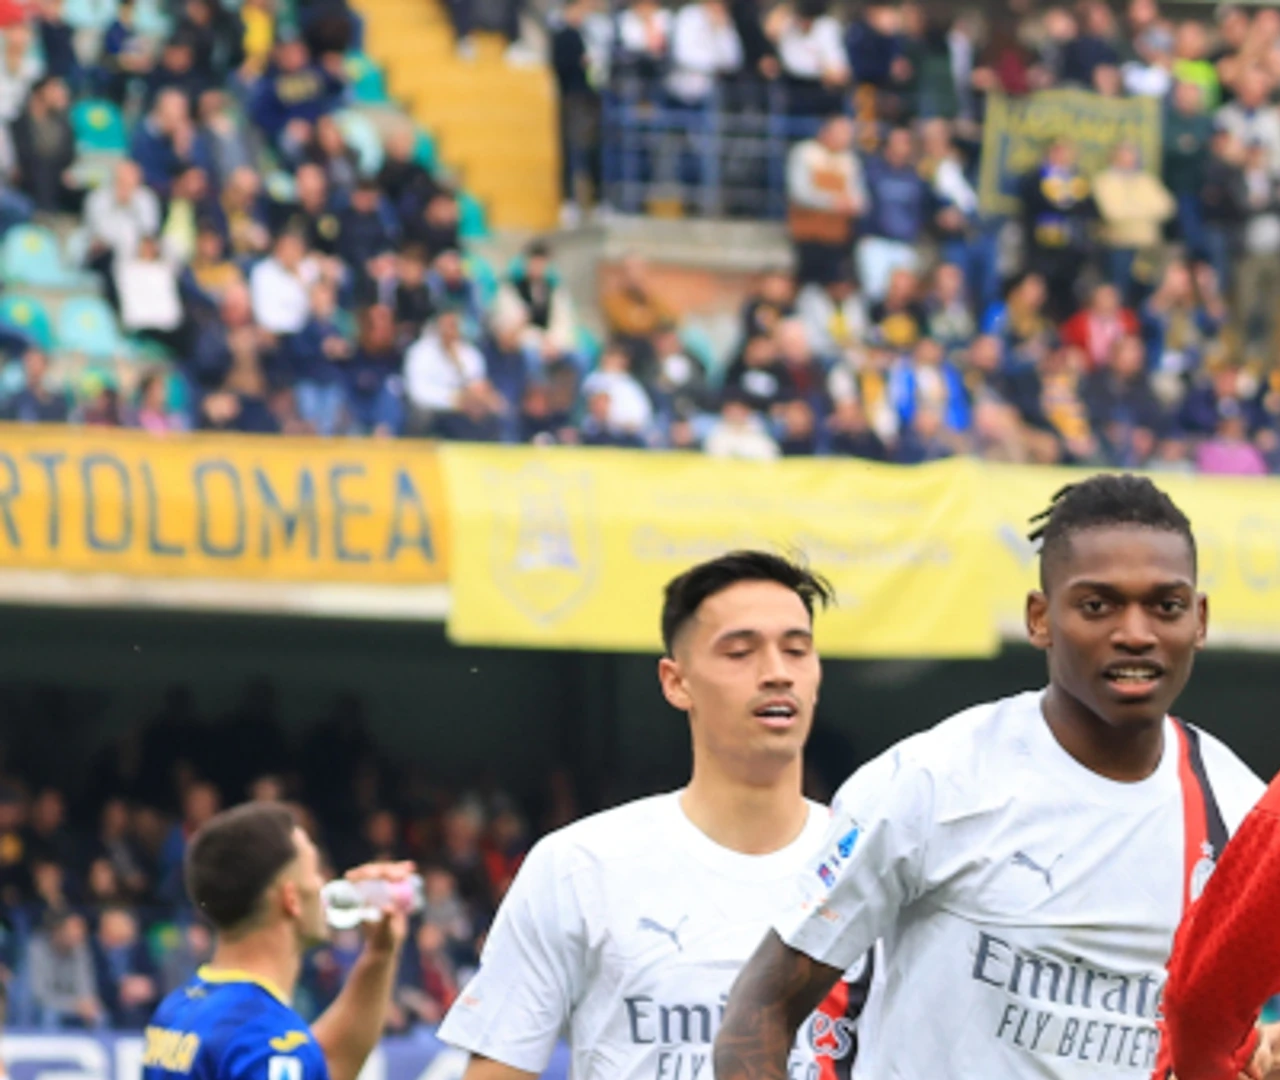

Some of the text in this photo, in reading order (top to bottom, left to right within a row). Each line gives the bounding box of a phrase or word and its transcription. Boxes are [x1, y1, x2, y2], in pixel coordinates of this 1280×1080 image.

[972, 930, 1165, 1018] Emirat
[996, 1003, 1159, 1071] FLY BETTER
